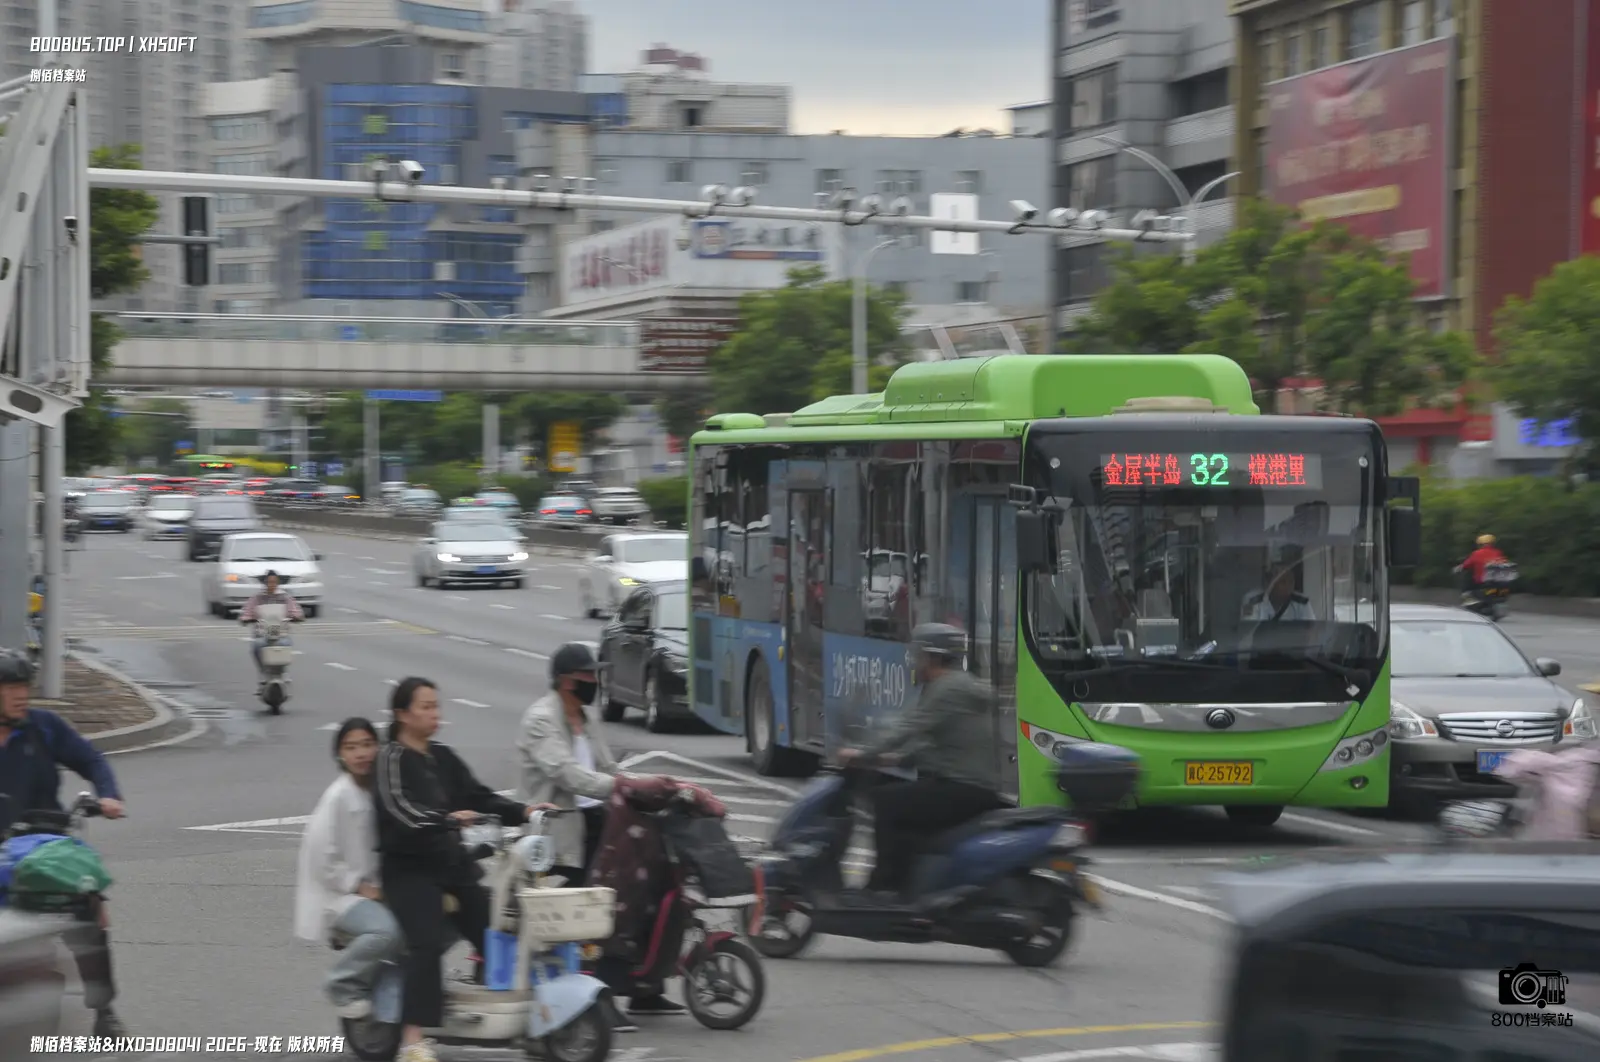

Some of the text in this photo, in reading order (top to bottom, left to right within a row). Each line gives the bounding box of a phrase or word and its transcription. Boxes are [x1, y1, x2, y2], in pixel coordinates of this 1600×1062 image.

[1104, 453, 1306, 486] 金屋半岛 32 煤港里
